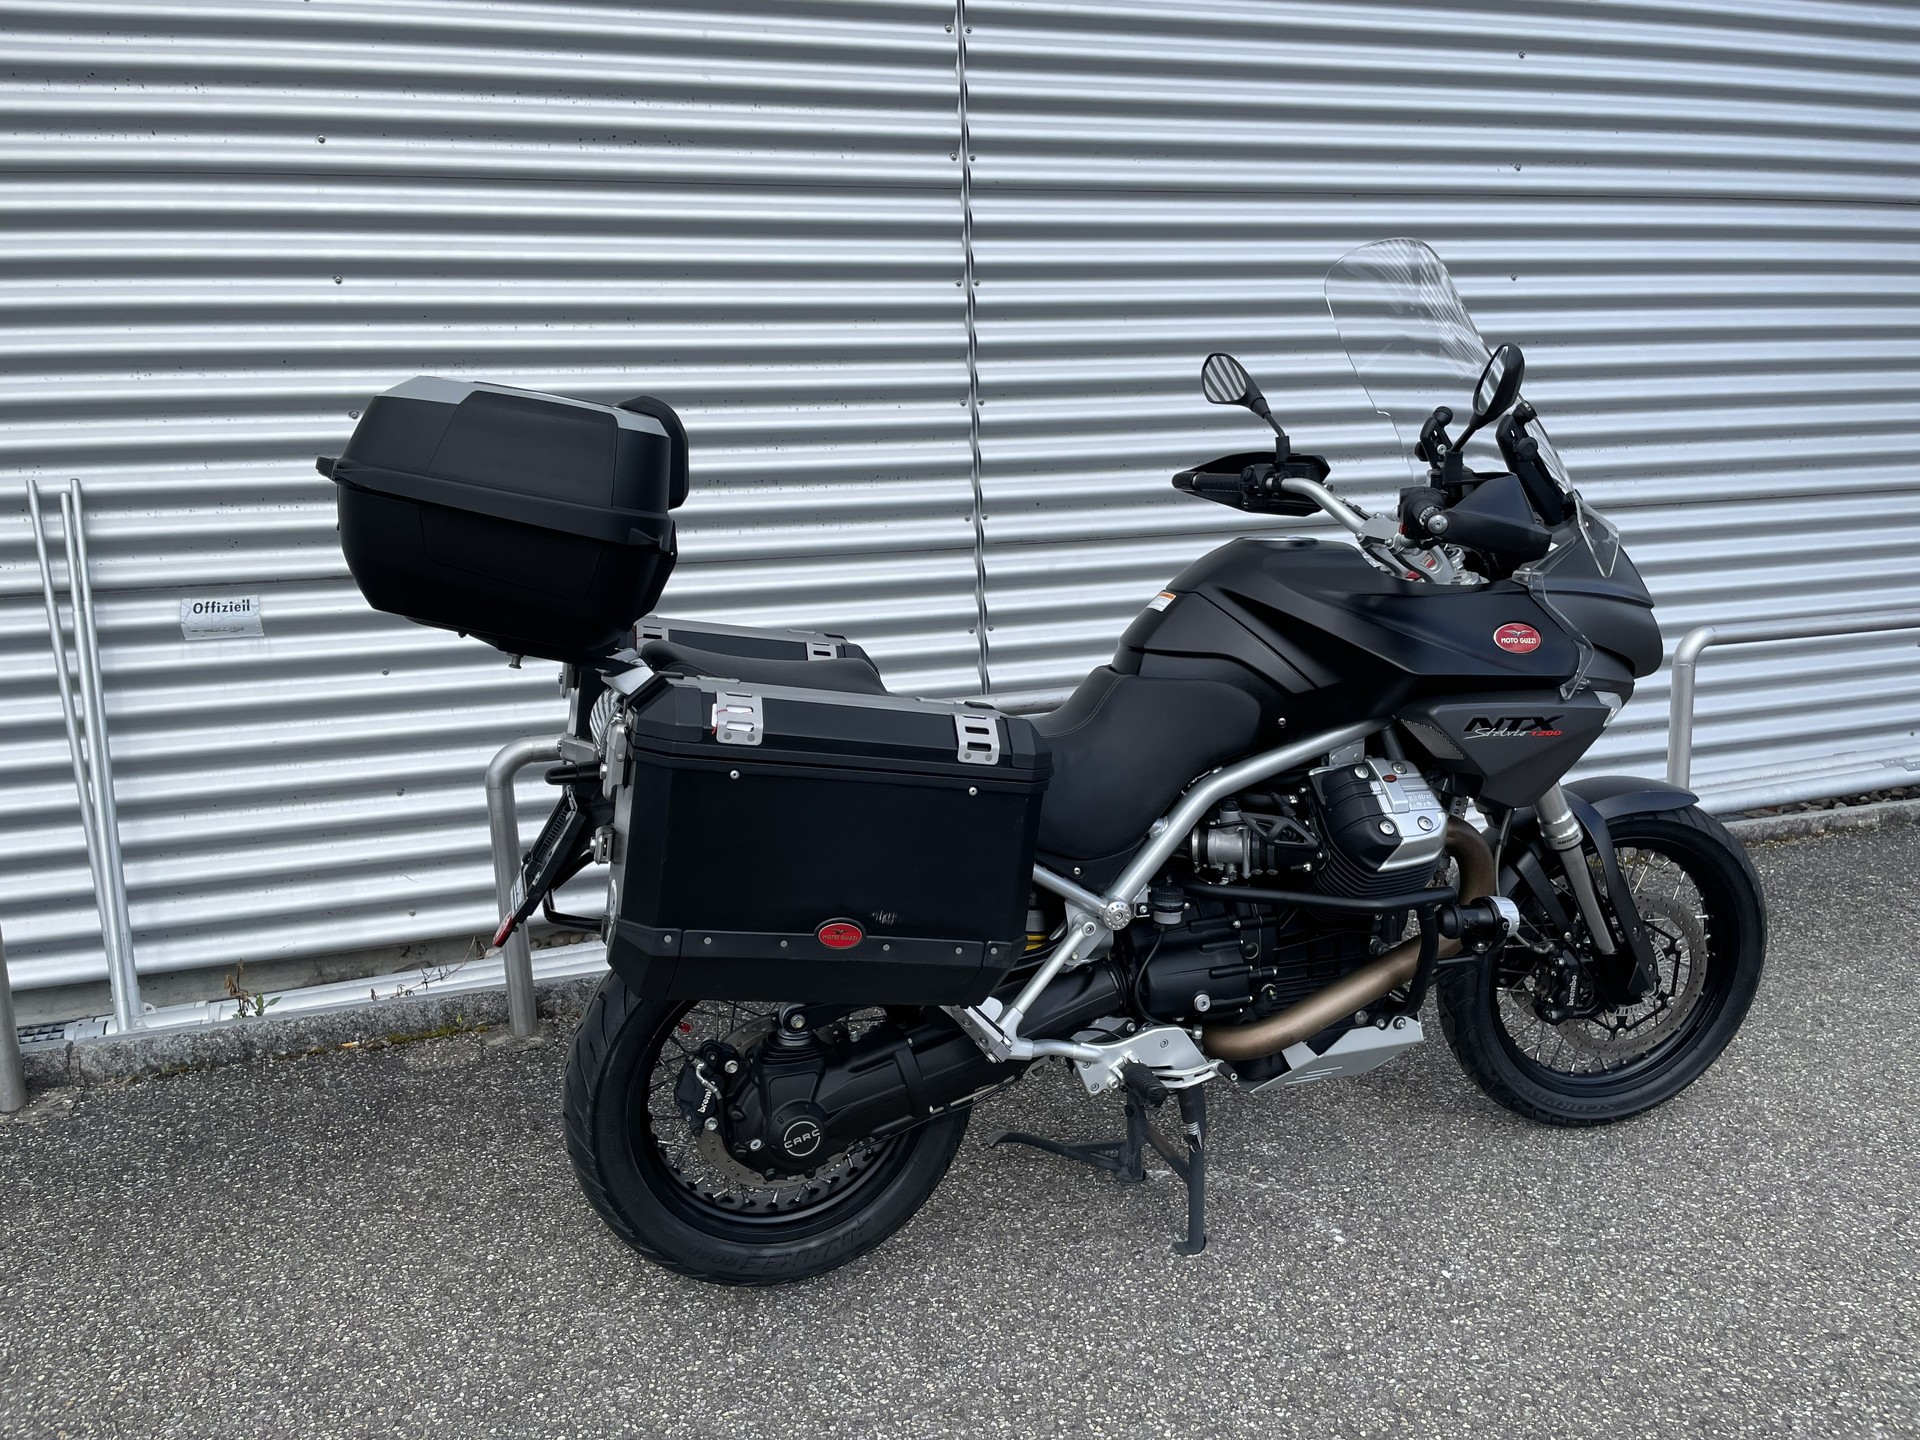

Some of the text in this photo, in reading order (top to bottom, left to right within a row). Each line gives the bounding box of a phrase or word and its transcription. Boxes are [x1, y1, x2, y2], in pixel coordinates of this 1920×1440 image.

[1463, 714, 1566, 732] NTX
[1463, 727, 1562, 740] Stelvio 1200
[1566, 974, 1578, 1006] brembo
[697, 1080, 716, 1113] brem
[783, 1128, 821, 1150] CARC
